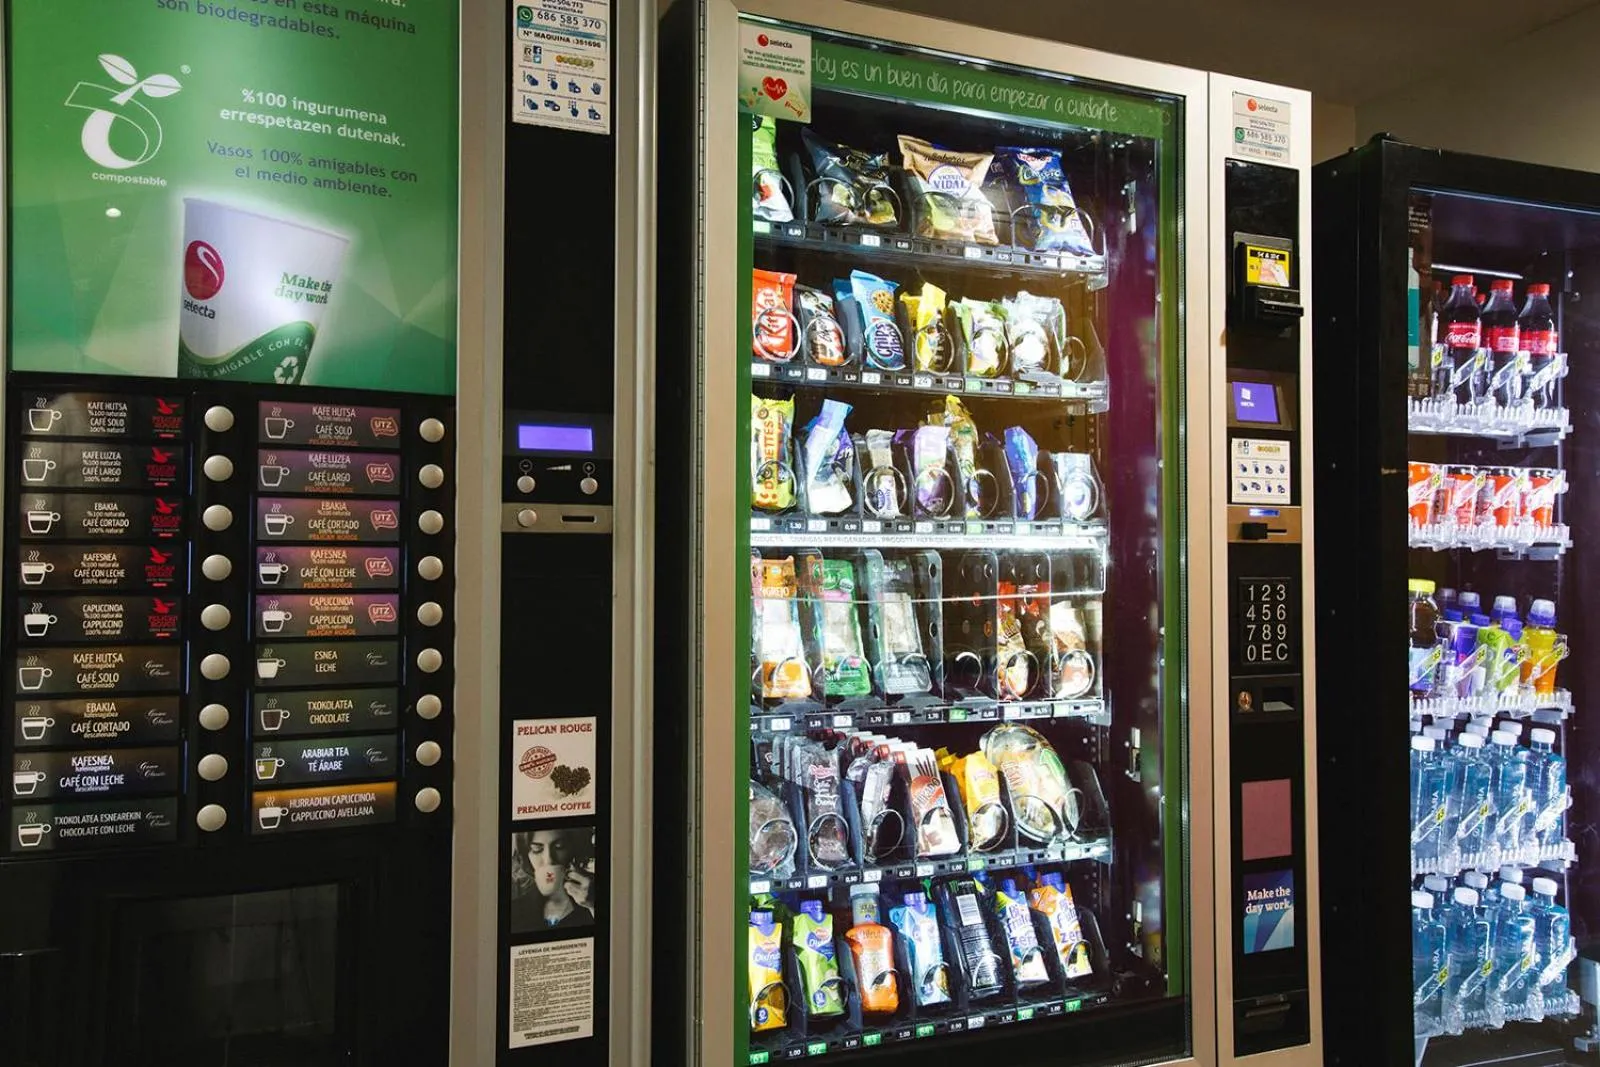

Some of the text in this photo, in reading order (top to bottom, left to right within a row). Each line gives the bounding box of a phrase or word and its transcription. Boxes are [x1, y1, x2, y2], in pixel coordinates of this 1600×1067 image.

[157, 0, 341, 40] son biodegradables.
[303, 2, 339, 18] esta
[345, 8, 416, 35] máquina
[537, 11, 601, 30] 686 585 370
[534, 32, 571, 43] MAQUINA
[841, 62, 858, 78] es
[864, 63, 883, 83] un
[887, 61, 923, 89] buen
[926, 70, 949, 95] día
[952, 78, 986, 101] para
[990, 84, 1051, 111] empezar
[1054, 97, 1064, 112] a
[1067, 99, 1118, 123] cuidarte
[241, 87, 388, 126] %100 ingurumena
[219, 107, 406, 148] errespetazen dutenak.
[207, 140, 418, 184] Vasos 100% amigables con
[91, 171, 168, 187] compostable
[235, 164, 393, 199] el medio ambiente.
[933, 180, 967, 190] VIDAL
[281, 272, 332, 292] Make the
[274, 285, 305, 304] day
[183, 299, 216, 320] selecta
[873, 323, 893, 358] Chips
[213, 337, 291, 377] AMIGABLE CON
[87, 402, 128, 411] KAFE HUTSA
[312, 406, 357, 417] KAFE HUTSA
[90, 417, 125, 427] CAFÉ SOLO
[374, 420, 392, 429] UTZ
[315, 423, 353, 436] CAFÉ SOLO
[82, 451, 122, 460] KAFE LUZEA
[308, 454, 351, 464] KAFE LUZEA
[82, 466, 121, 476] CAFÉ LARGO
[308, 470, 351, 482] CAFÉ LARGO
[370, 467, 388, 475] UTZ
[94, 503, 118, 511] EBAKIA
[321, 501, 347, 511] EBAKIA
[82, 517, 130, 527] CAFÉ CORTADO
[374, 513, 392, 521] UTZ
[308, 518, 360, 530] CAFÉ CORTADO
[83, 553, 117, 562] KAFESNEA
[310, 550, 348, 559] KAFESNEA
[369, 560, 387, 568] UTZ
[74, 568, 125, 578] CAFÉ CON LECHE
[300, 566, 356, 578] CAFÉ CON LECHE
[1248, 584, 1286, 601] 1 2 3
[372, 607, 390, 615] UTZ
[1246, 604, 1286, 621] 4 5 6
[82, 620, 123, 629] CAPPUCCINO
[309, 615, 354, 625] CAPPUCCINO
[1247, 623, 1286, 641] 7 8 9
[314, 650, 338, 661] ESNEA
[1247, 643, 1288, 661] 0 E C
[73, 653, 124, 664] KAFE HUTSA
[315, 662, 337, 673] LECHE
[76, 671, 120, 683] CAFÉ SOLO
[86, 702, 117, 712] EBAKIA
[307, 699, 353, 711] TXOKOLATEA
[309, 713, 350, 725] CHOCOLATE
[71, 720, 131, 733] CAFÉ CORTADO
[517, 723, 592, 736] PELICAN ROUGE
[301, 747, 350, 759] ARABIAR TEA
[71, 755, 115, 767] KAFESNEA
[308, 760, 343, 772] TÉ ÁRABE
[60, 774, 125, 788] CAFÉ CON LECHE
[289, 796, 330, 808] HURRADUN
[517, 802, 591, 814] PREMIUM COFFEE
[54, 815, 99, 826] TXOKOLATEA
[100, 812, 142, 822] ESNEAREKIN
[291, 806, 375, 823] CAPPUCCINO AVELLANA
[59, 824, 136, 838] CHOCOLATE CON LECHE
[1247, 886, 1291, 901] Make the
[1245, 903, 1264, 916] day
